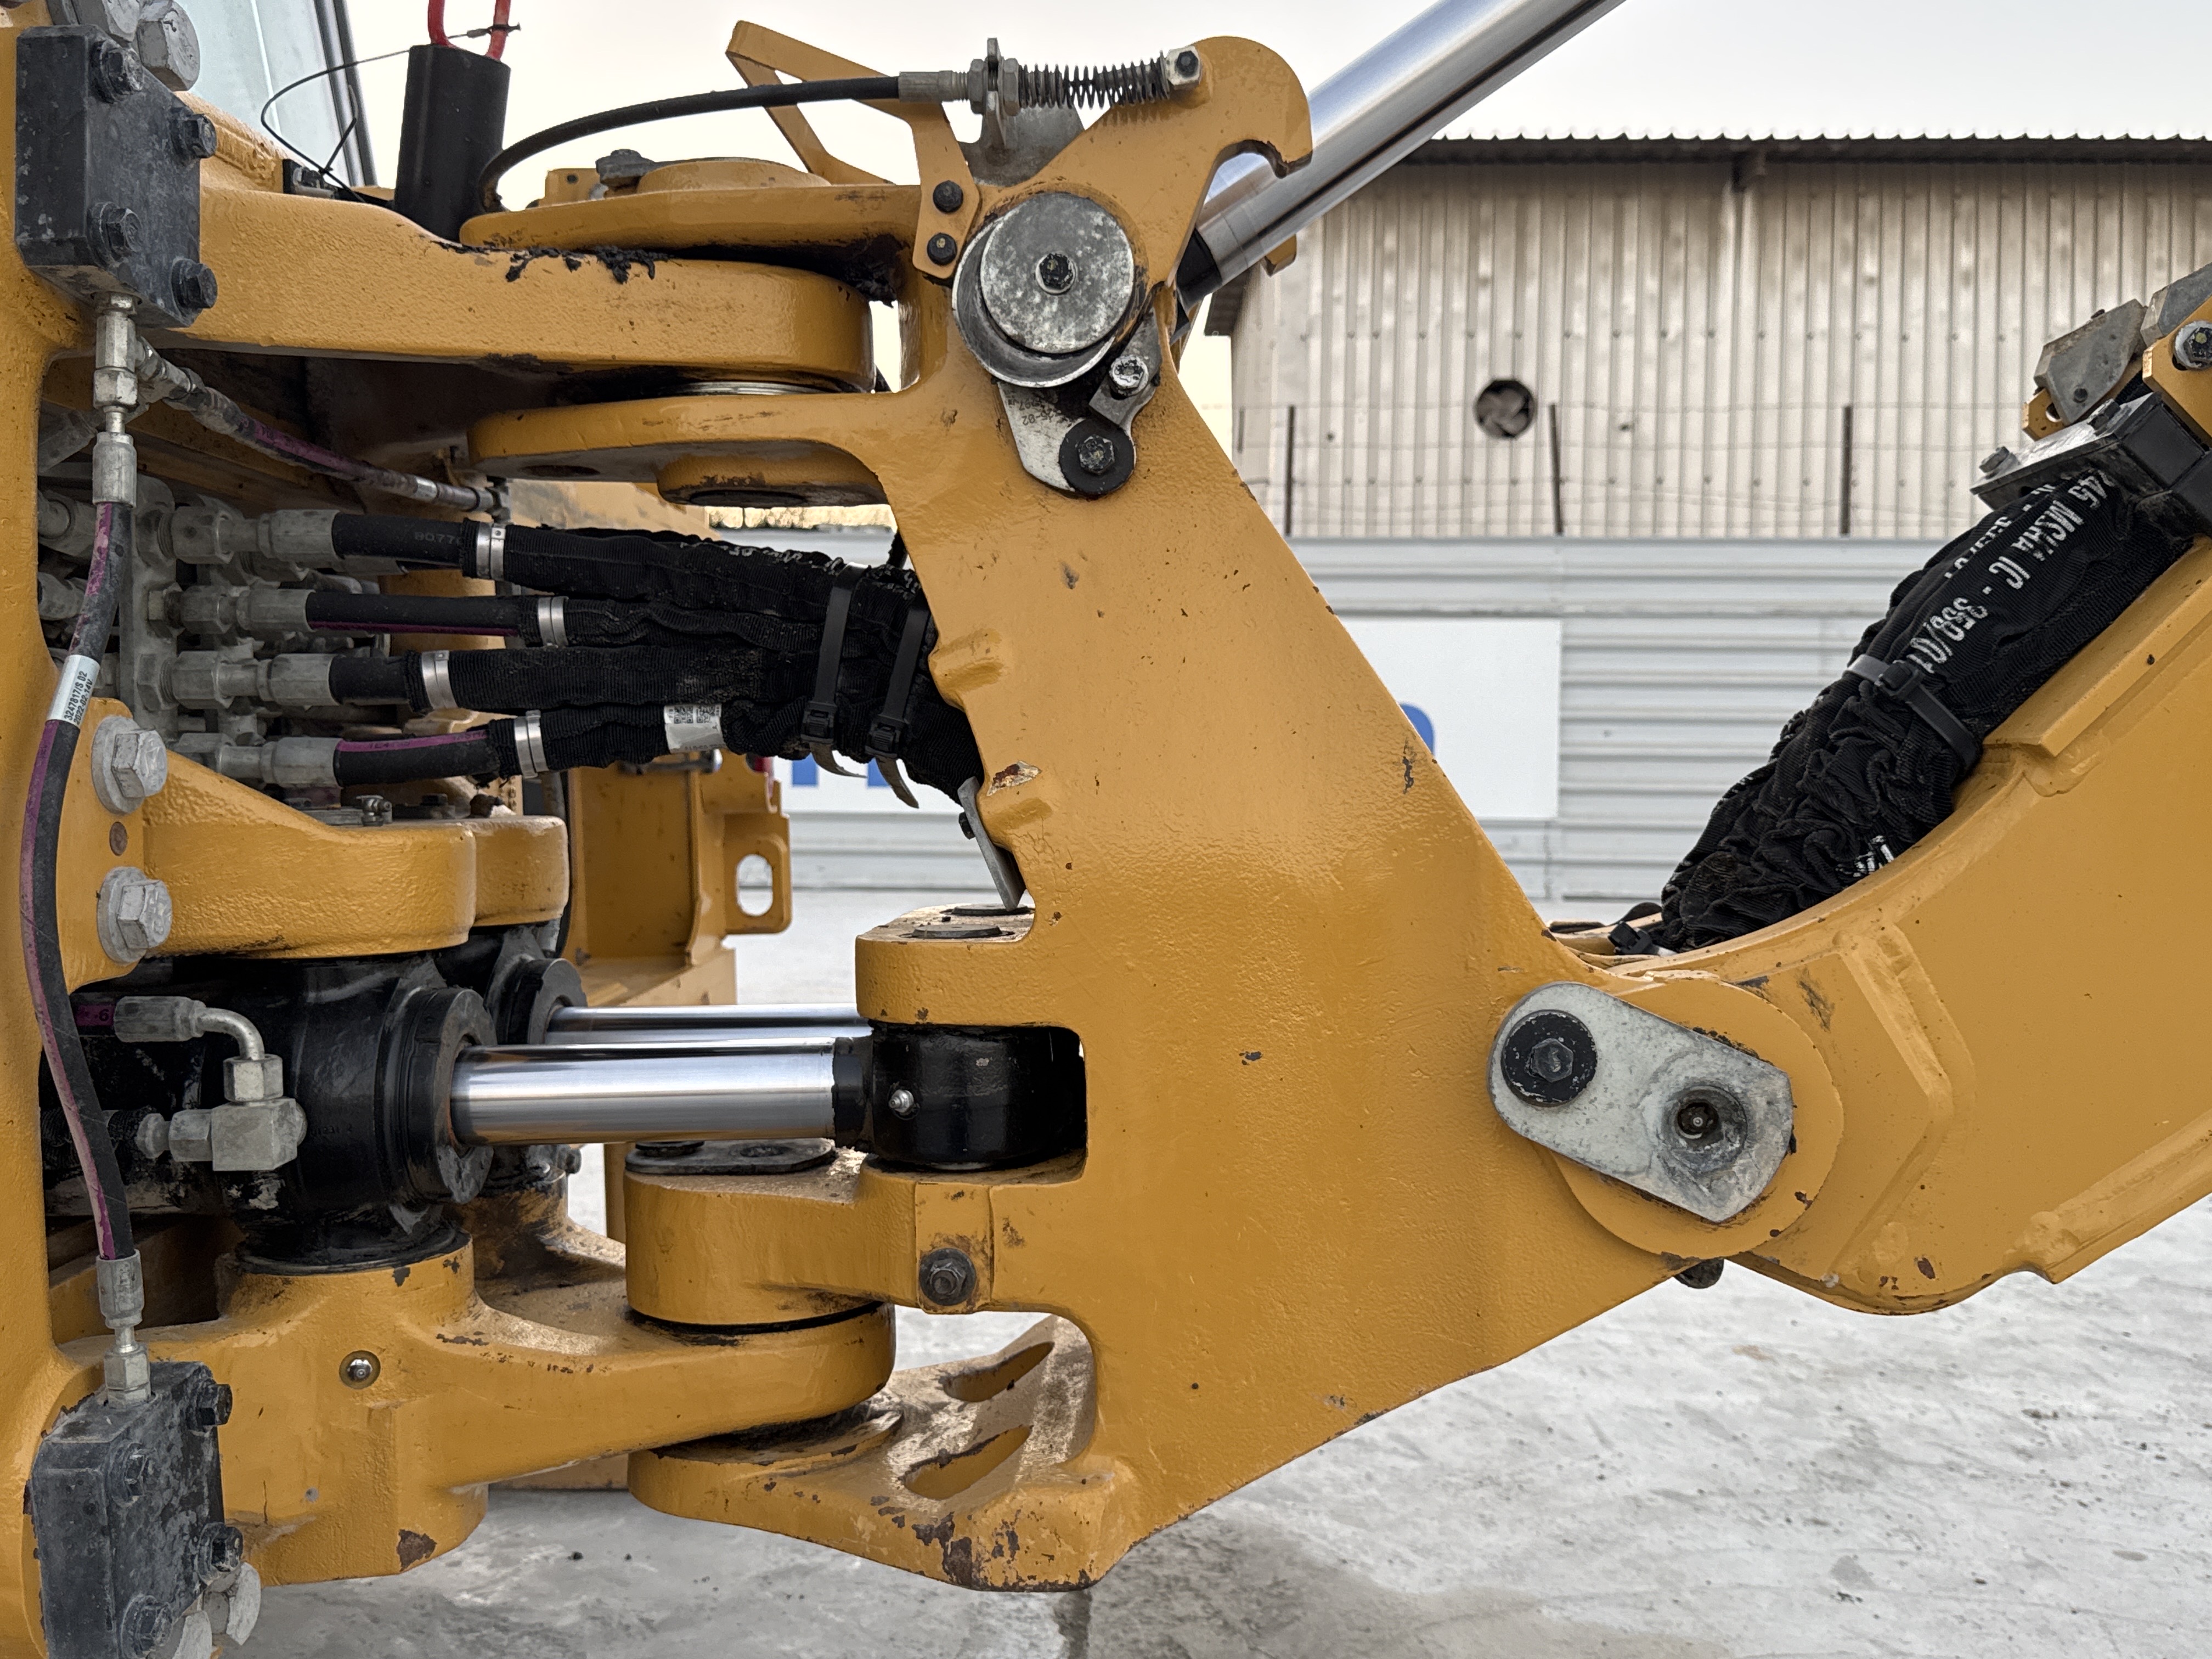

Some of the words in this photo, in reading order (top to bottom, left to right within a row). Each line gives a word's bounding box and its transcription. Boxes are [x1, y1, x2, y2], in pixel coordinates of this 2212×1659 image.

[2010, 500, 2085, 562] MSHA
[1988, 556, 2031, 590] IC
[64, 682, 84, 720] 3247817/S
[77, 670, 88, 681] 02
[74, 679, 93, 725] 2022-02-14V
